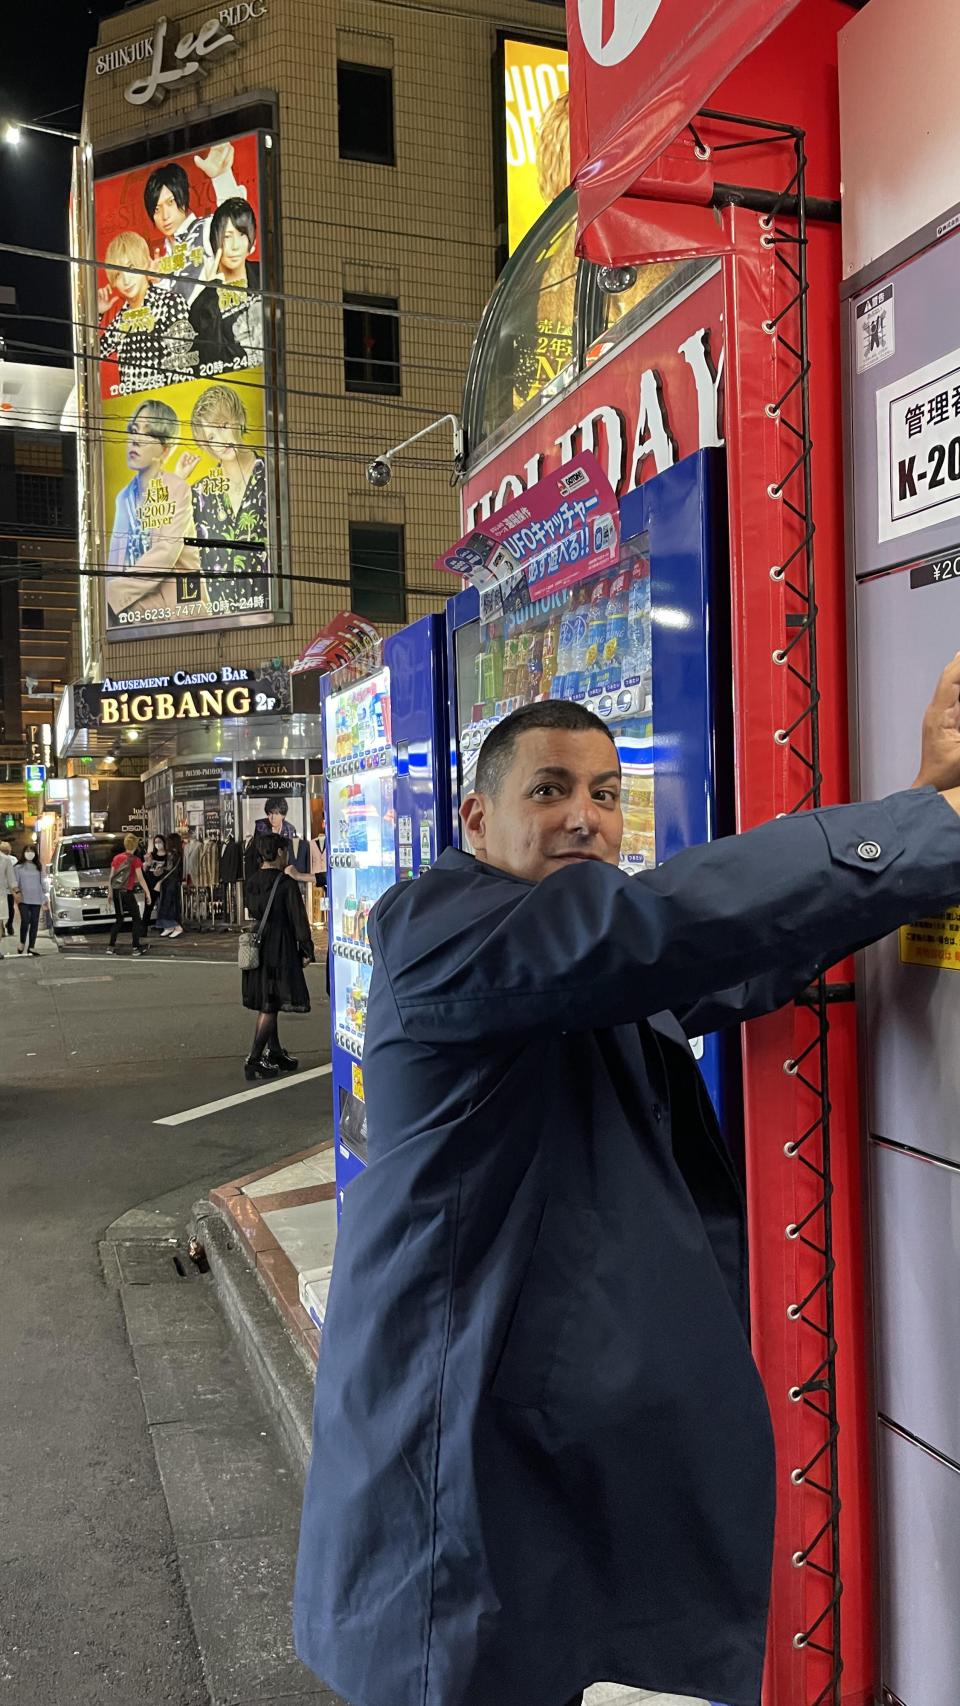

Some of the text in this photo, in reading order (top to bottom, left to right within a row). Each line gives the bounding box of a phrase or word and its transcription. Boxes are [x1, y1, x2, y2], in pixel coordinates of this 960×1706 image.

[124, 16, 235, 105] Lee
[141, 516, 173, 531] player
[503, 496, 598, 558] UFOキャッチャー
